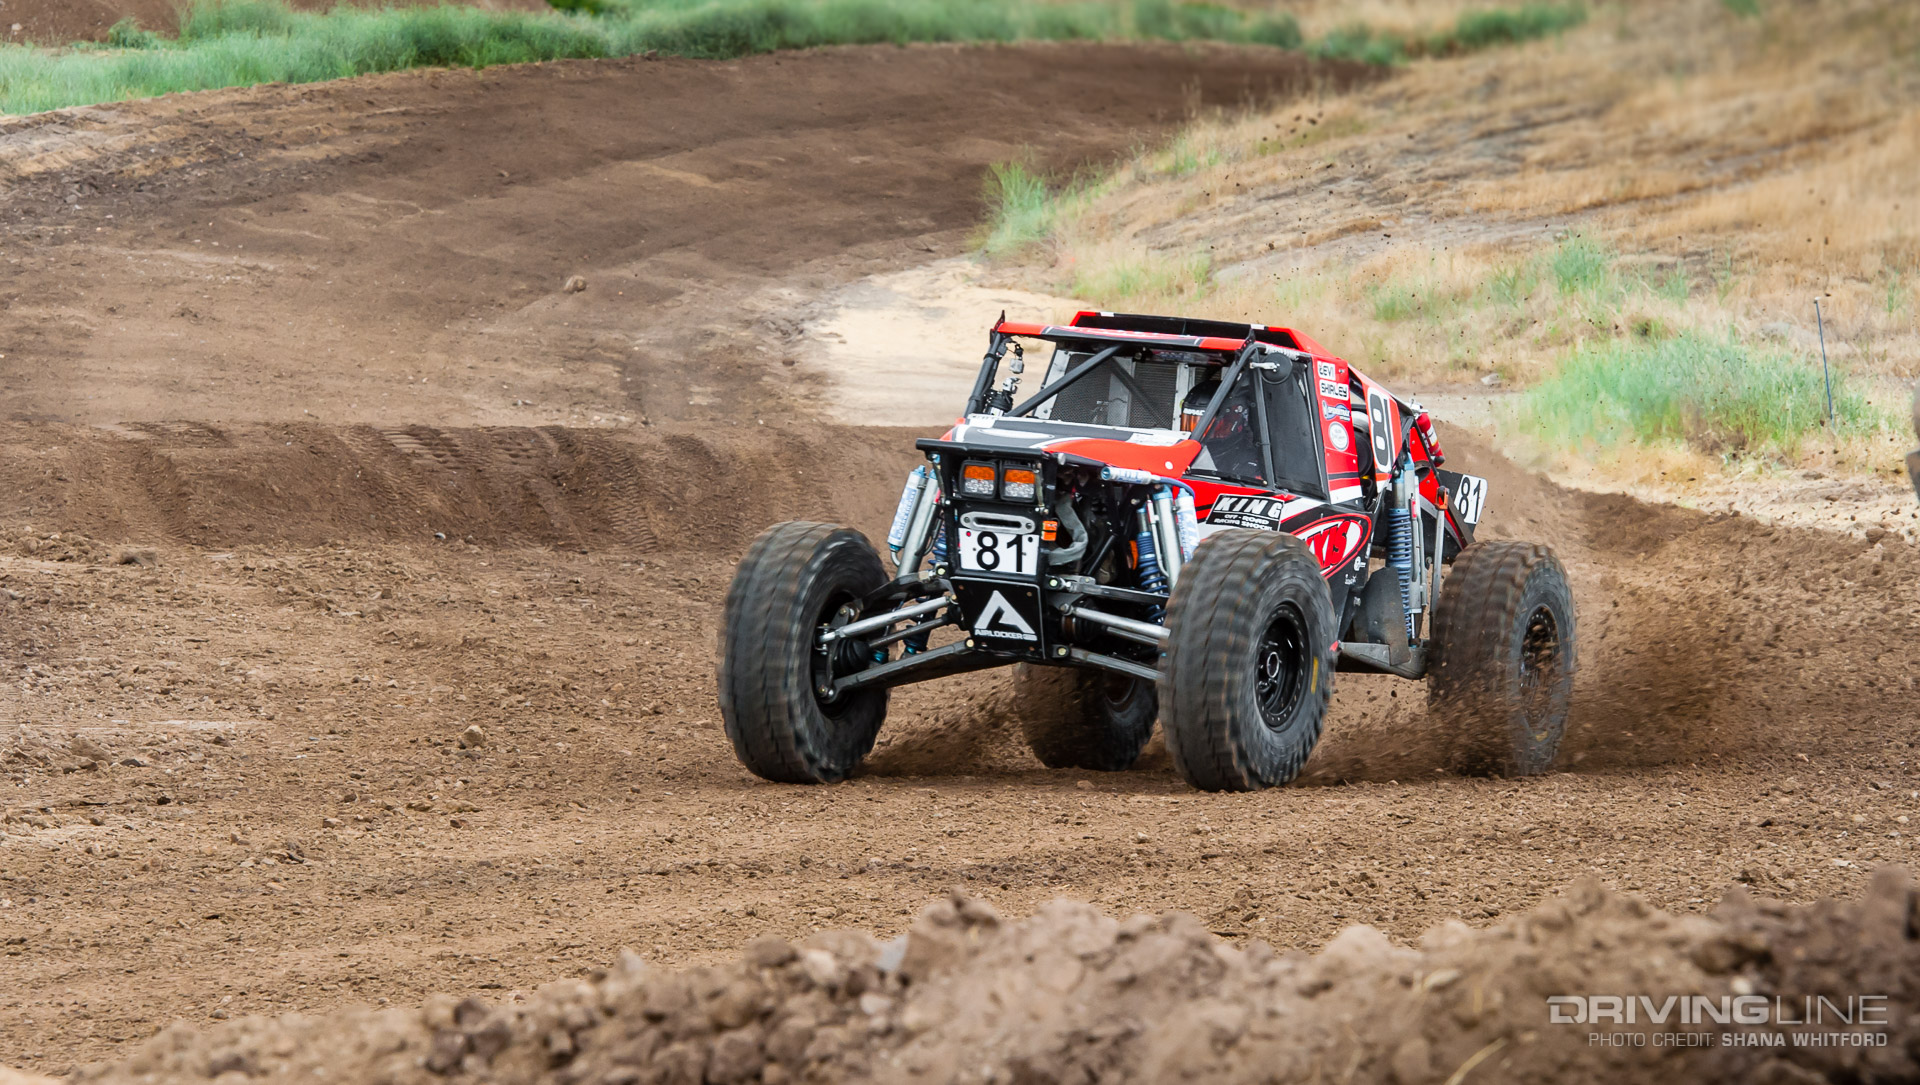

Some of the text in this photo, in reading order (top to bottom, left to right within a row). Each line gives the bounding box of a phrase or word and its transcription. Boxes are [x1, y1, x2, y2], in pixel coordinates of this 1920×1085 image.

[1318, 364, 1335, 378] LEVI
[1321, 382, 1348, 398] SHIRLEY
[1214, 497, 1283, 518] KING
[1458, 476, 1482, 523] 81
[976, 531, 1024, 573] 81
